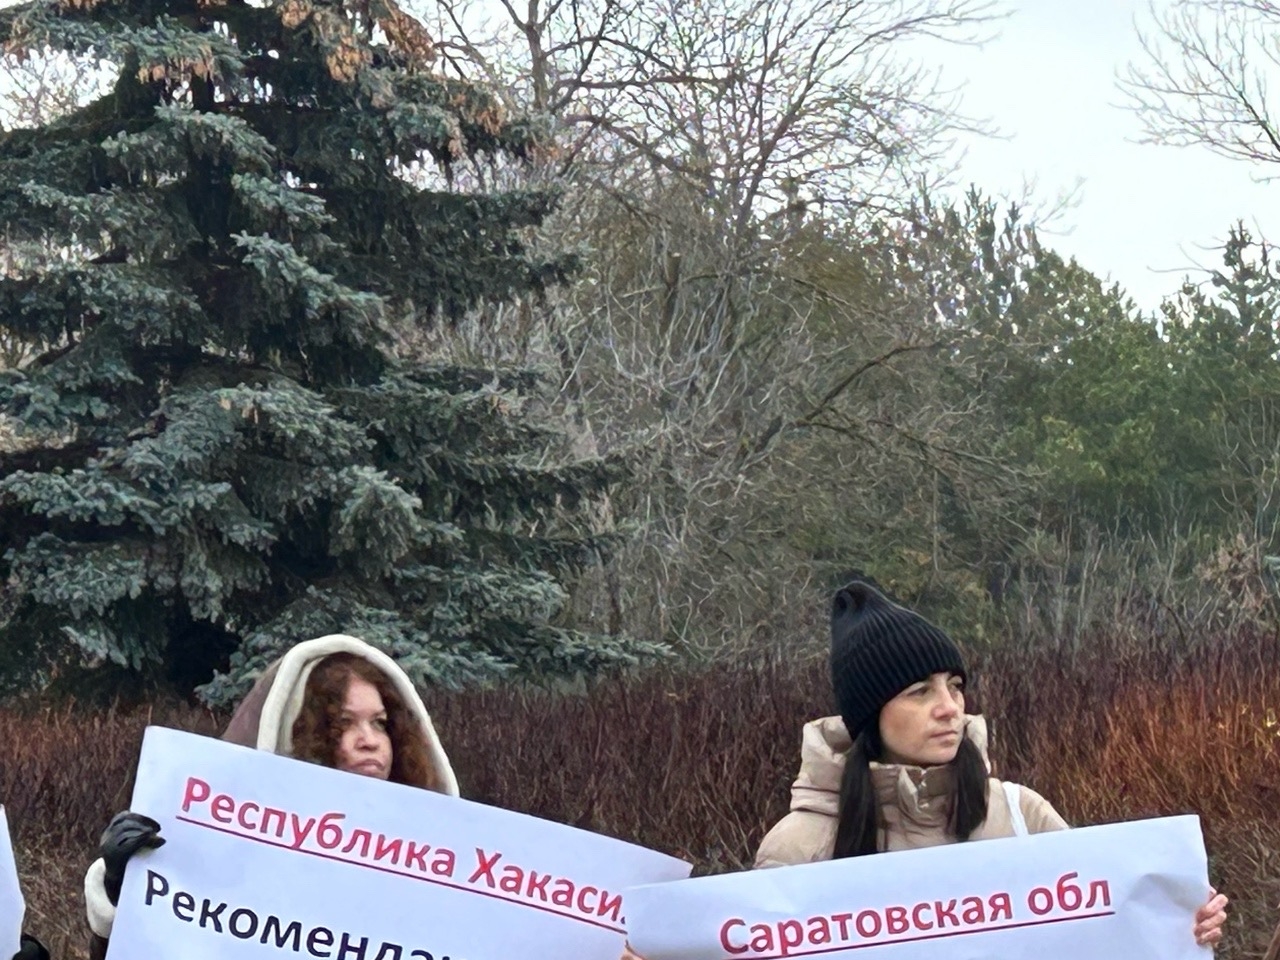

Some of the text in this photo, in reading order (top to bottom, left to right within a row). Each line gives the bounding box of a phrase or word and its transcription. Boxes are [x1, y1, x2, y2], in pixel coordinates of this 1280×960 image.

[182, 776, 455, 877] Республика
[719, 871, 1112, 958] Саратовская обл
